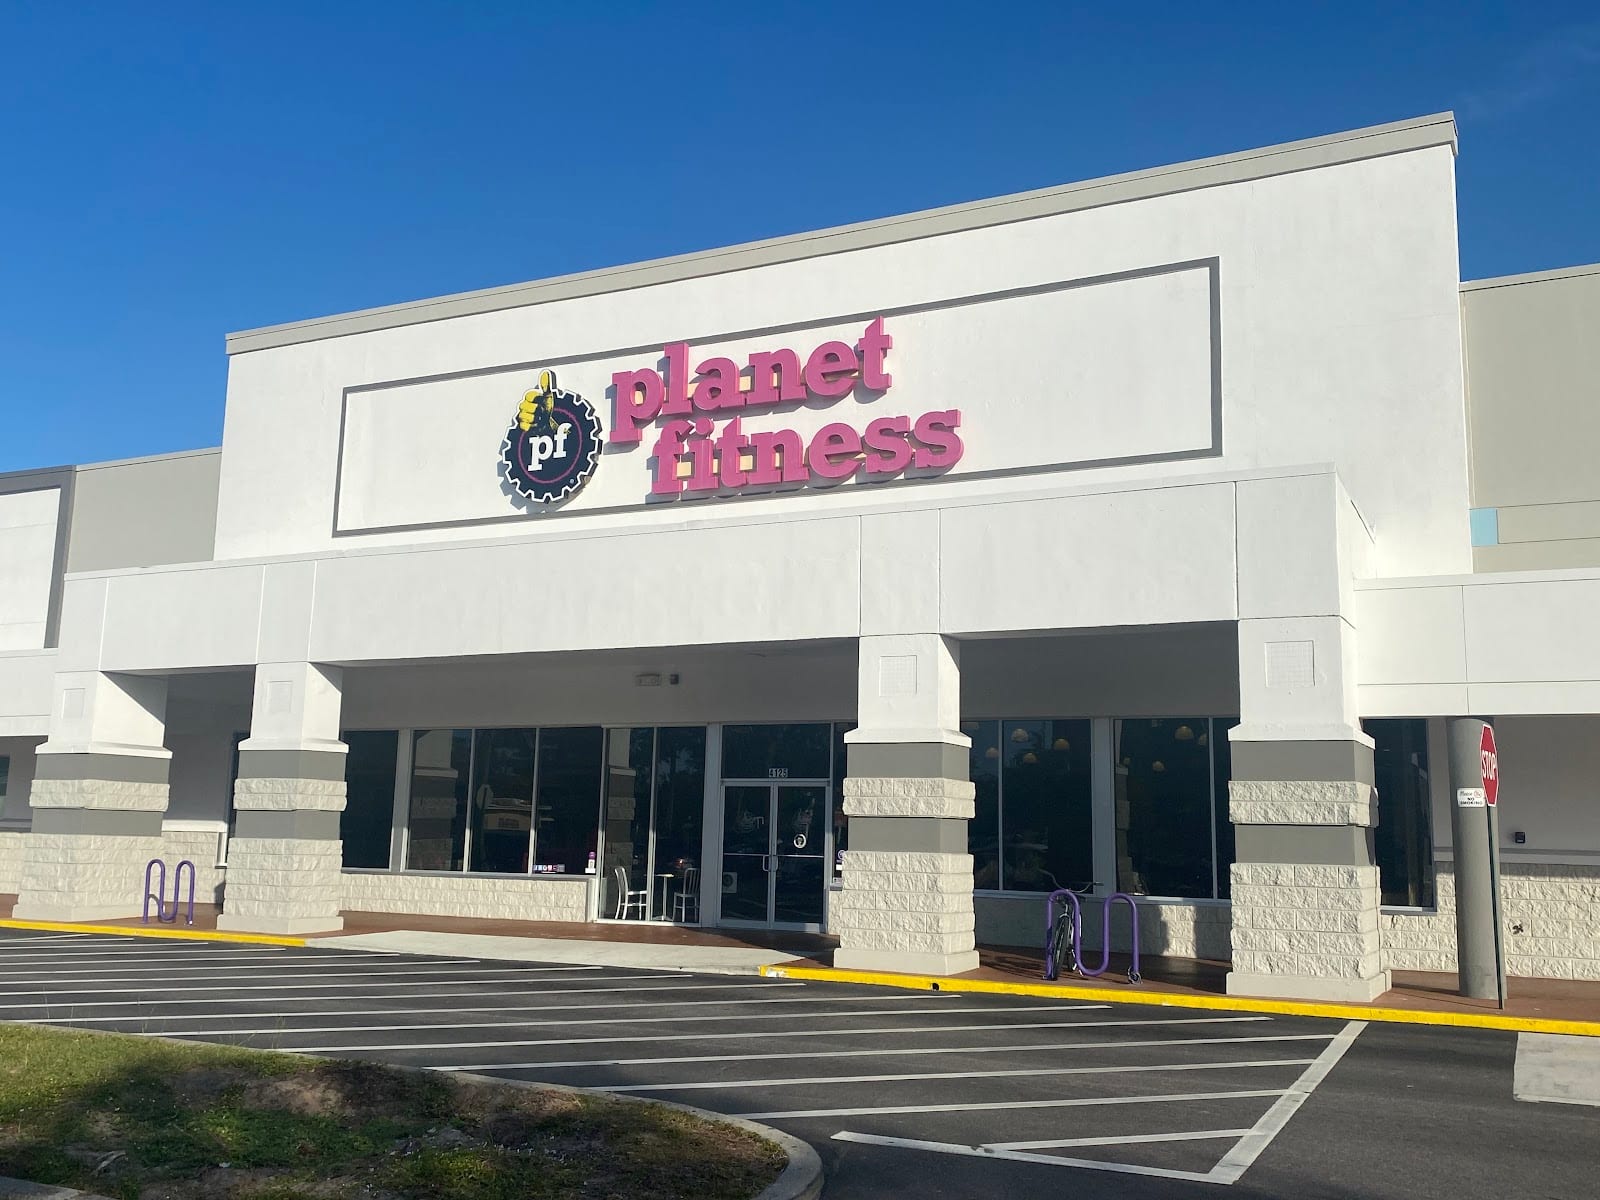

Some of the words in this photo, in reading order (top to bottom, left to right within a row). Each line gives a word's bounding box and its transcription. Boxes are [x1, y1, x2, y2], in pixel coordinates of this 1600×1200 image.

[608, 315, 893, 443] planet
[527, 422, 572, 472] pf
[650, 408, 965, 495] fitness
[1481, 749, 1496, 780] STOP
